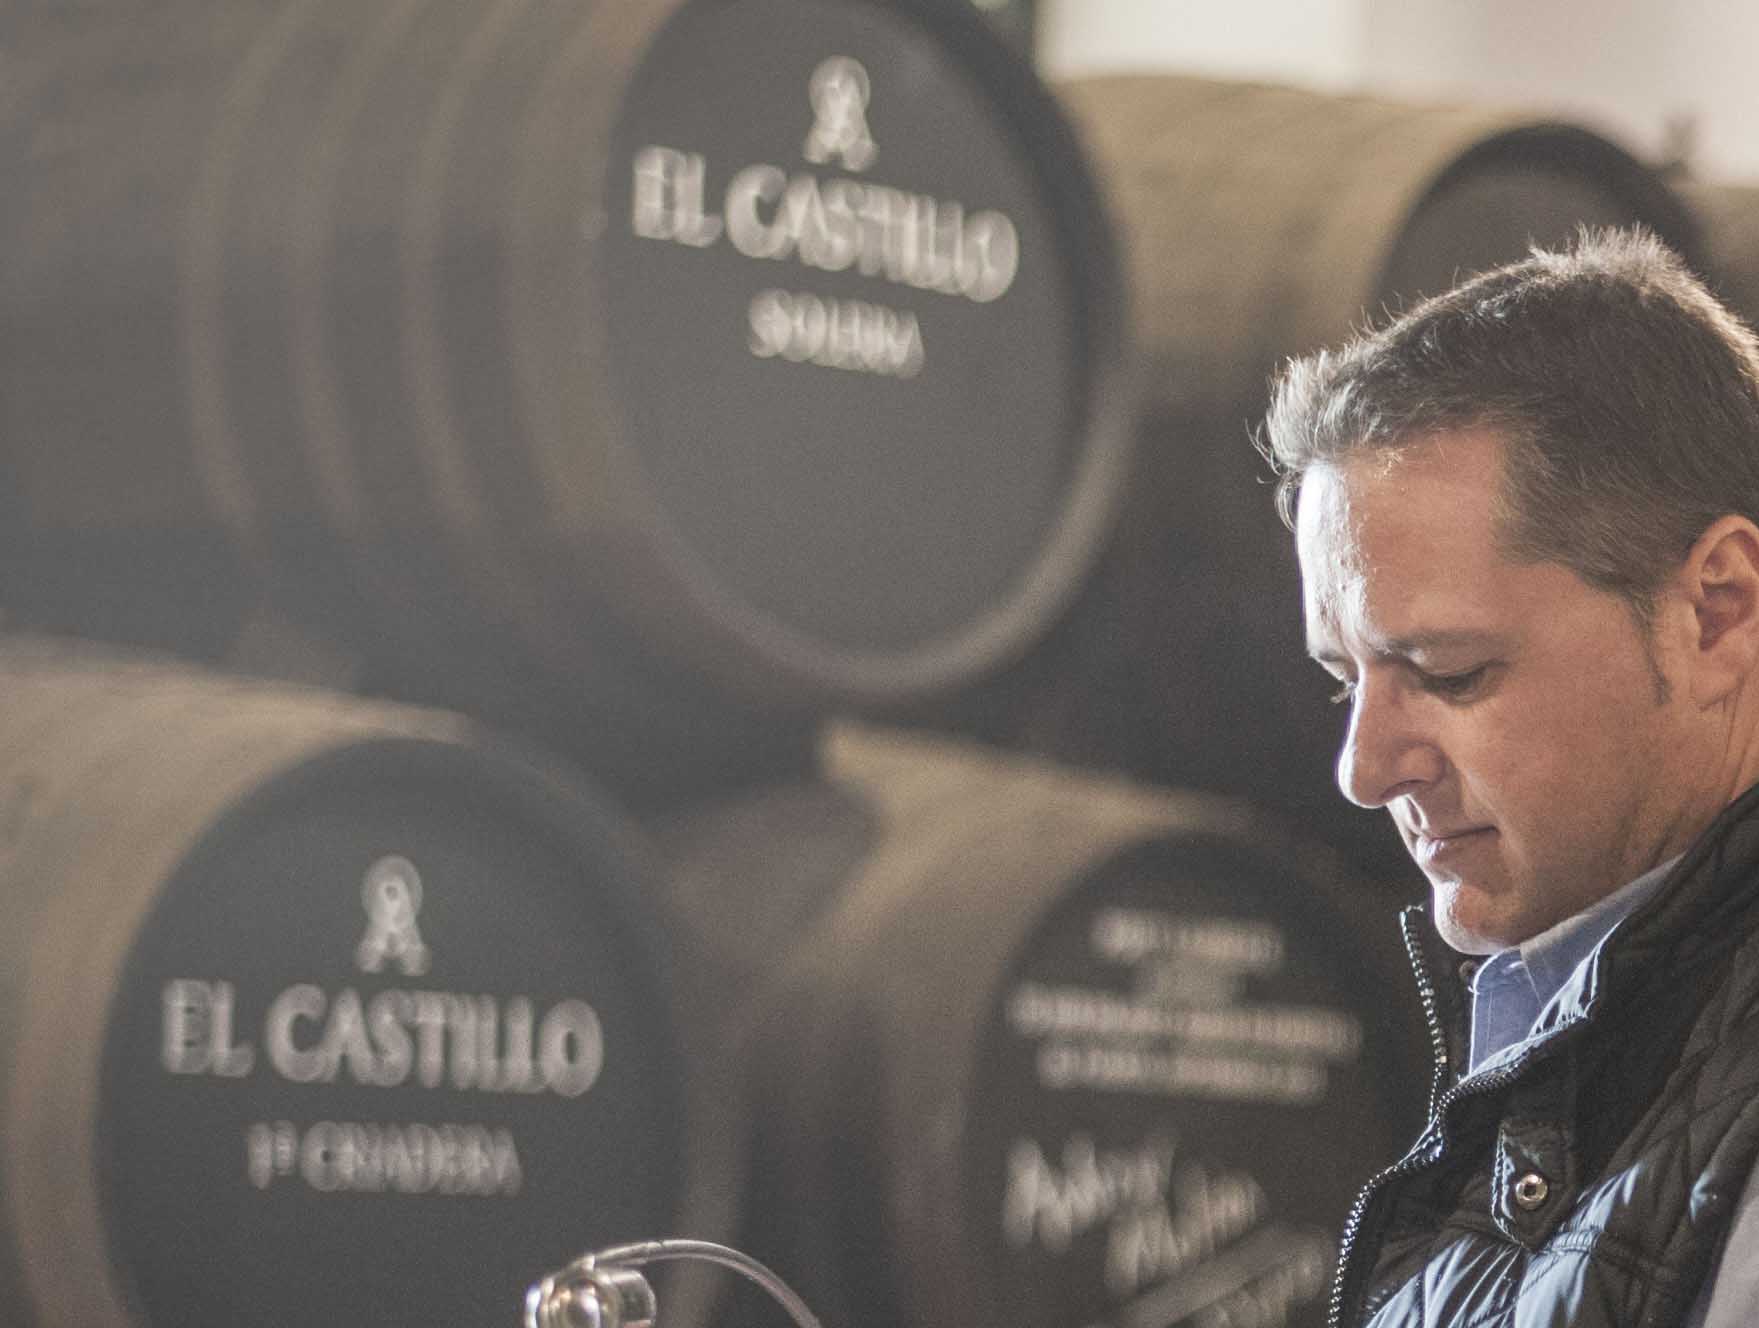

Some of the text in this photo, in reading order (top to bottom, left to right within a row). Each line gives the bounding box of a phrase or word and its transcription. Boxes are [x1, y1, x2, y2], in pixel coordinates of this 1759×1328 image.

[632, 145, 1019, 304] EL CASTILLO
[161, 978, 604, 1098] EL CASTILLO
